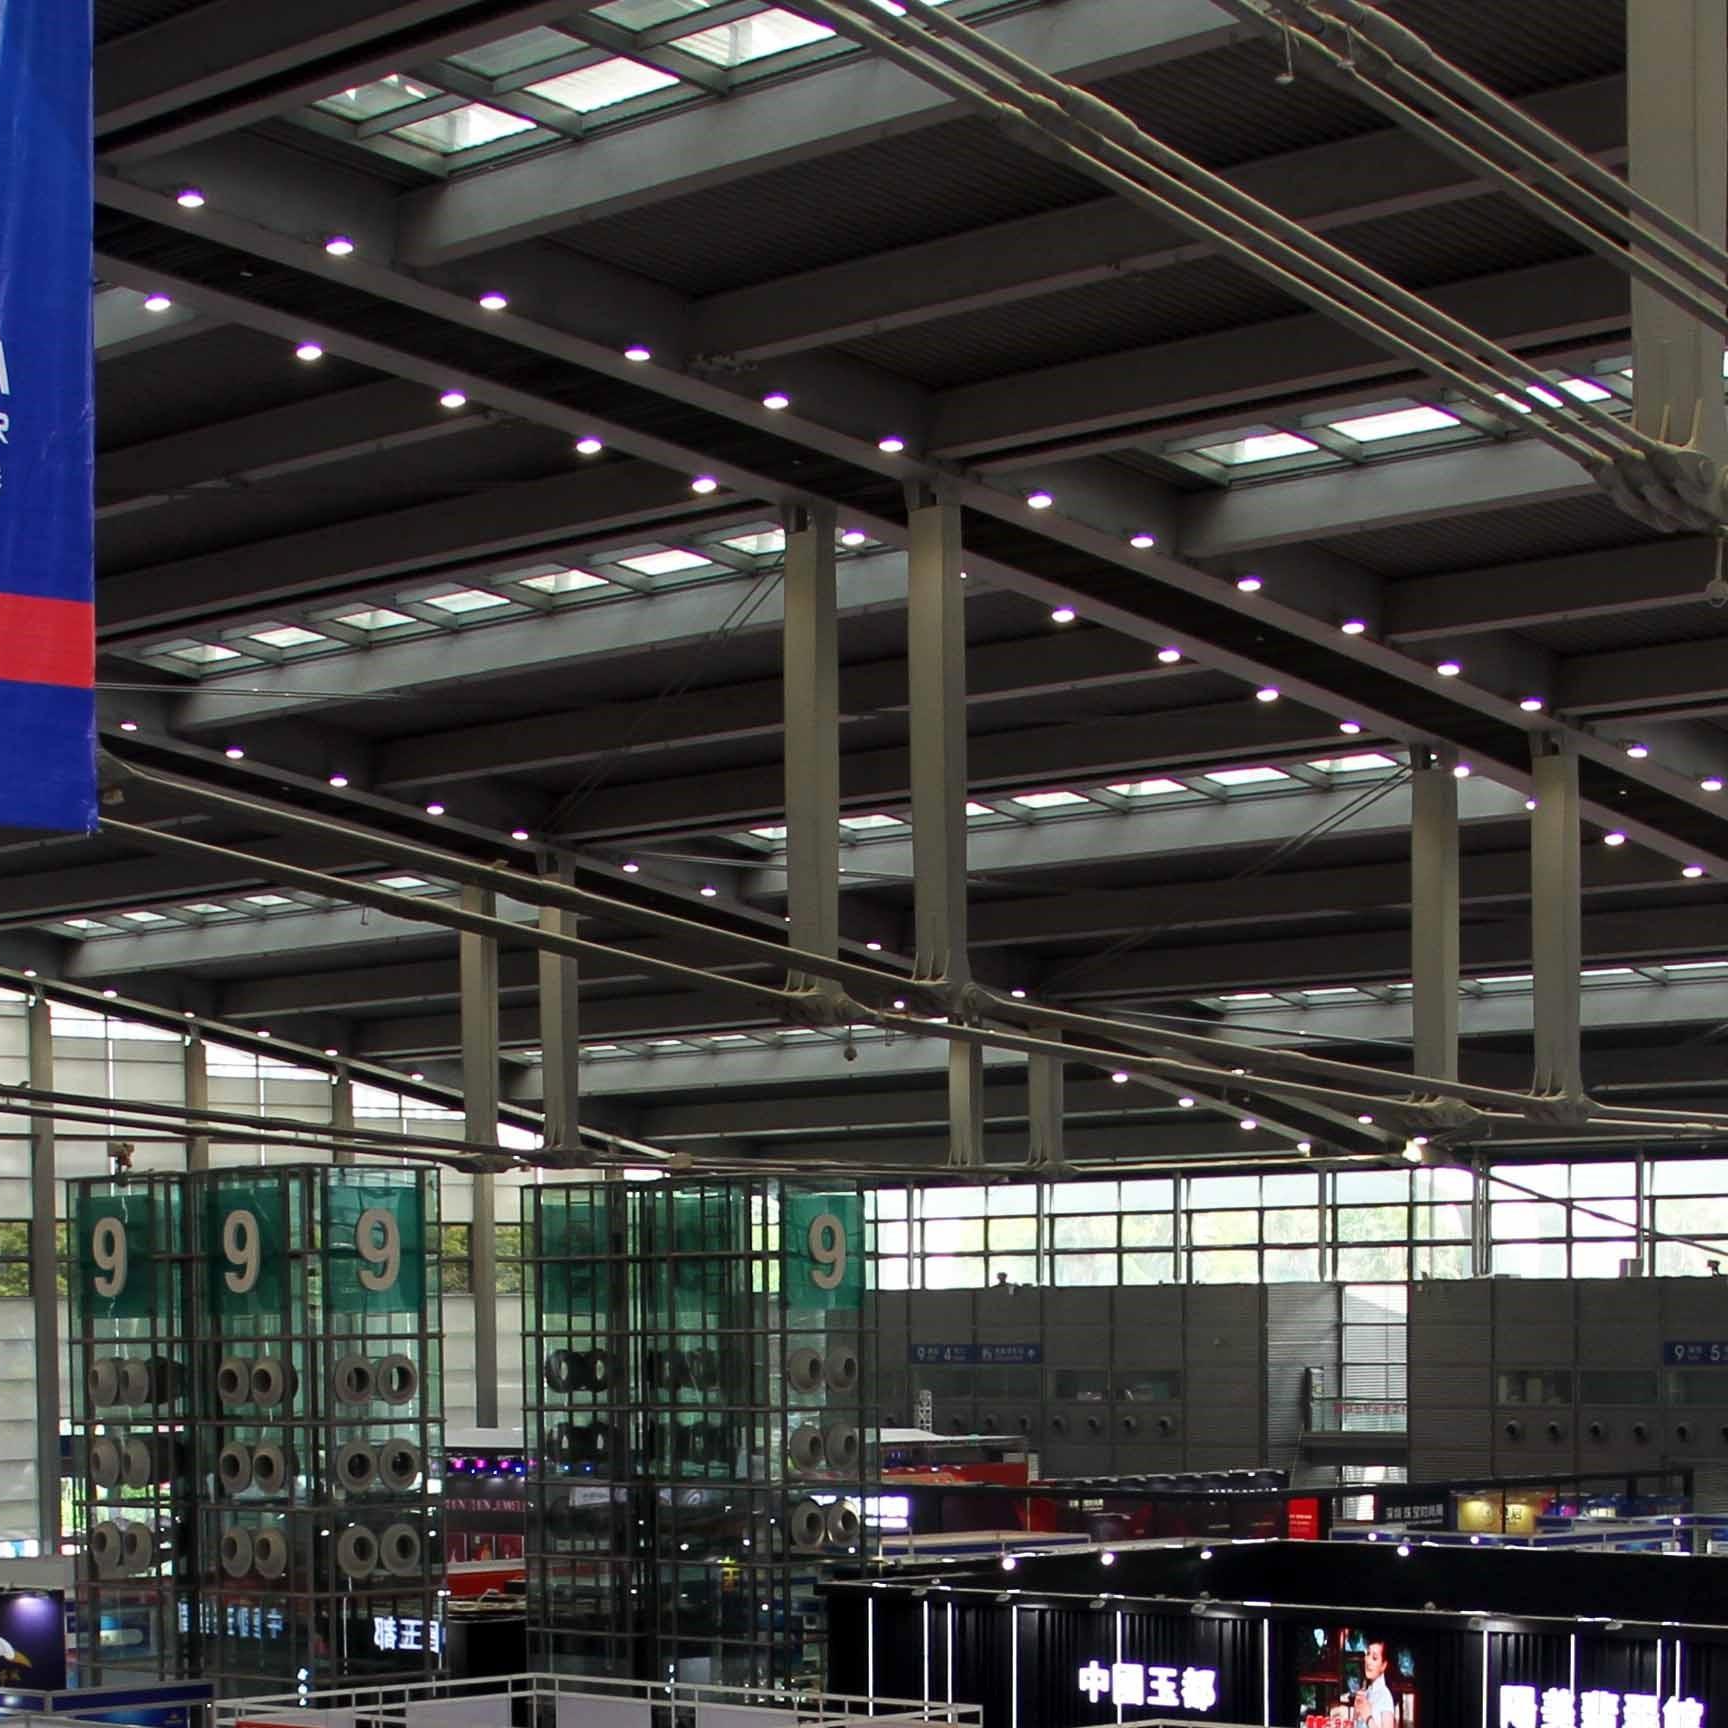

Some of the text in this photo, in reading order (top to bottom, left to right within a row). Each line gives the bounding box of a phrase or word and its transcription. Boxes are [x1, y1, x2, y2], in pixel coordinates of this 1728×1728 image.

[92, 1217, 129, 1298] 9
[224, 1207, 262, 1293] 9
[355, 1208, 400, 1292] 9
[809, 1211, 849, 1290] 9
